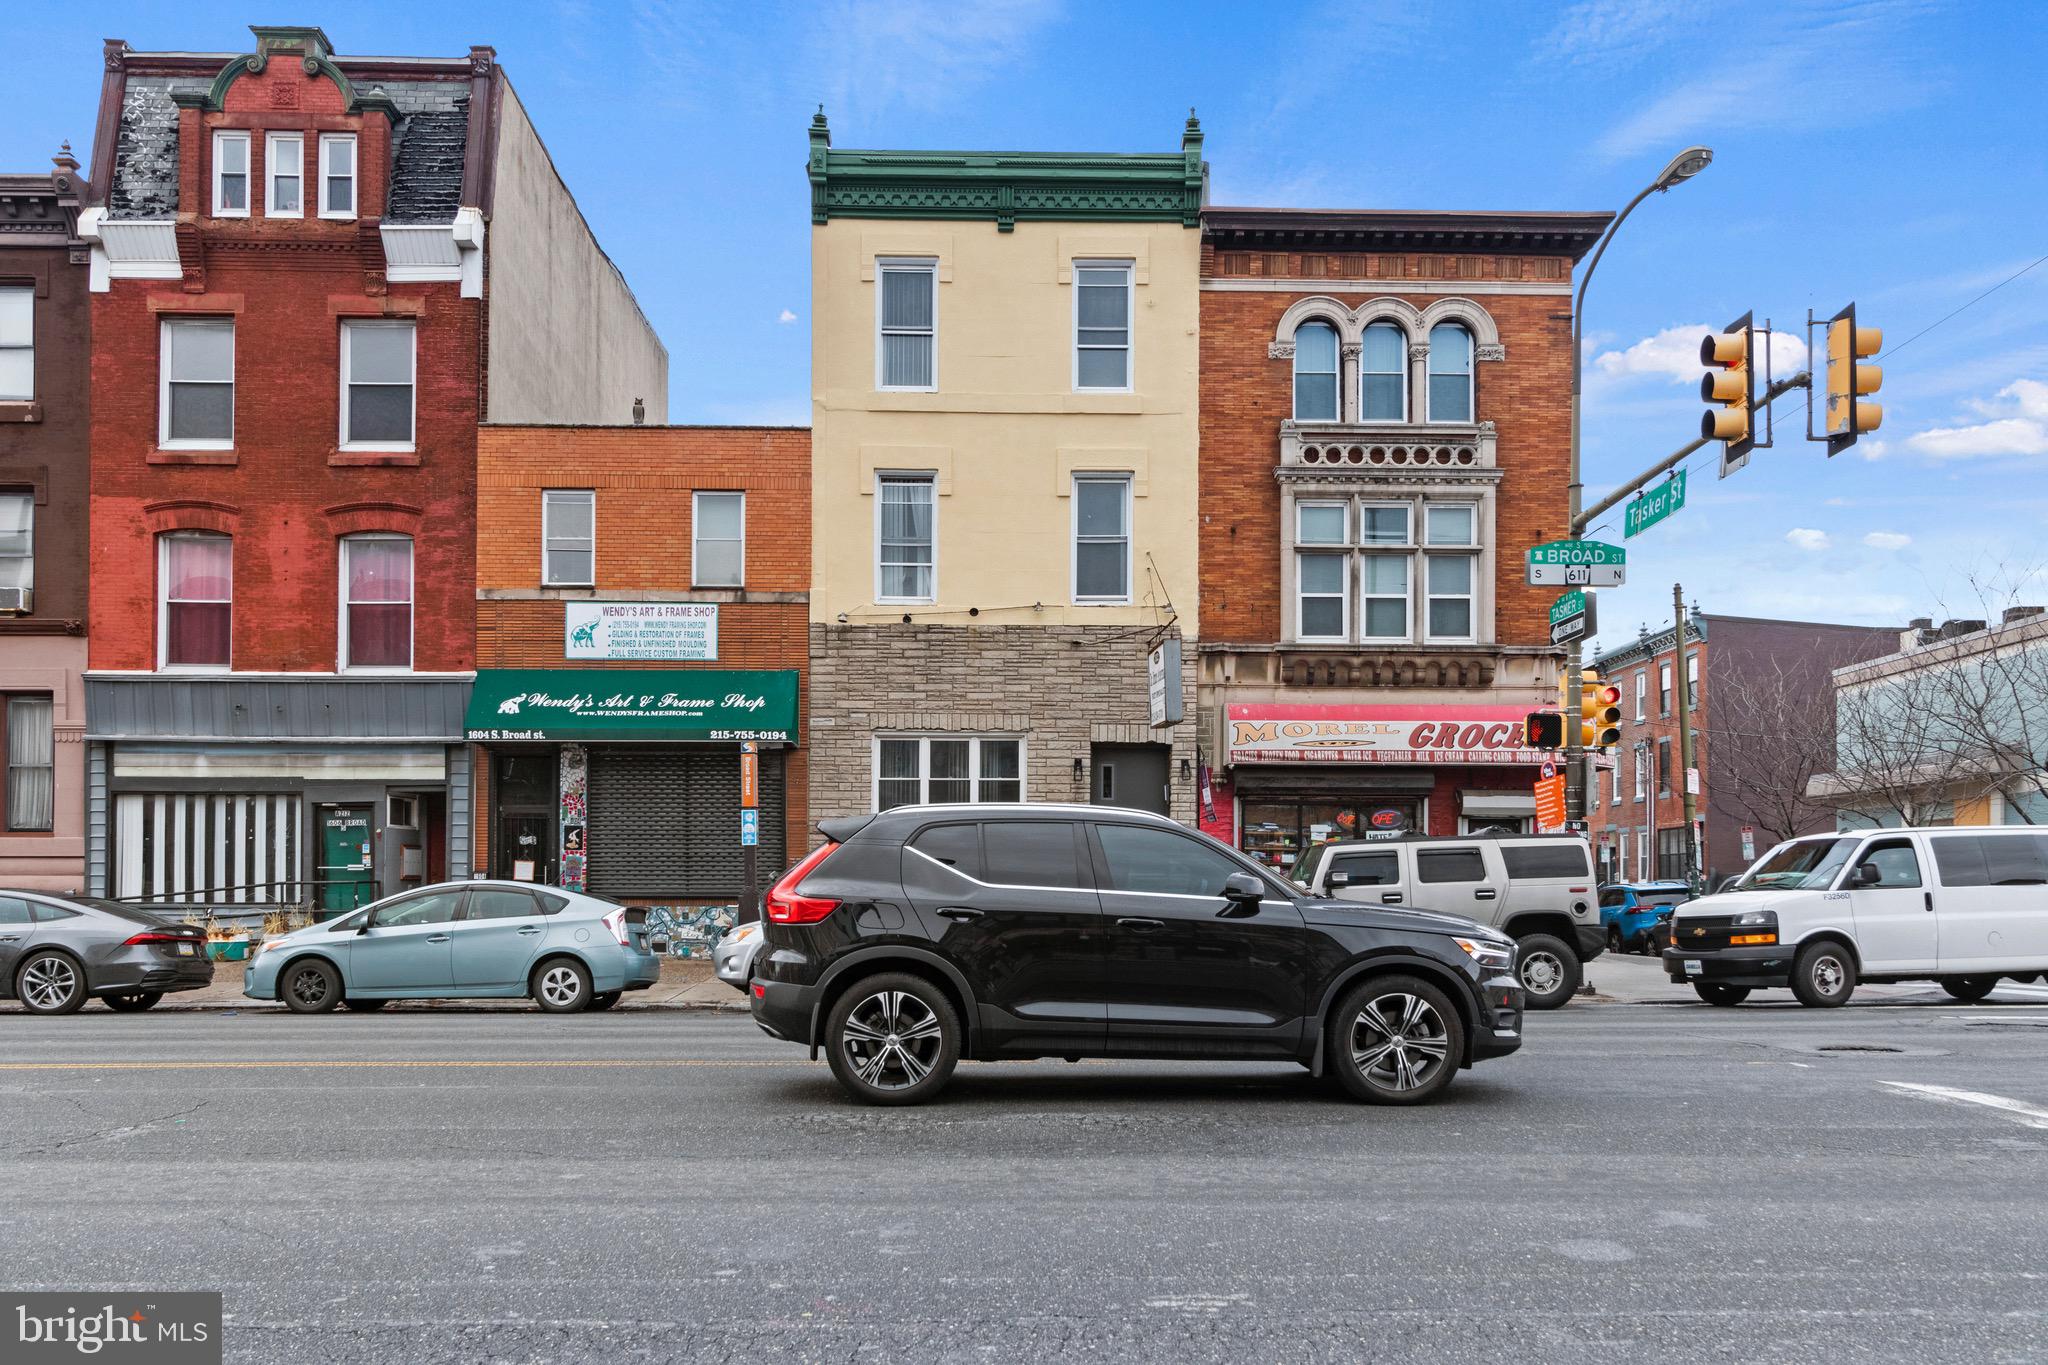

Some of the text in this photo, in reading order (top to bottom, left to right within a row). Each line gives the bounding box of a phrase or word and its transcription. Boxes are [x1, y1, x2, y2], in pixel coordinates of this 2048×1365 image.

[1630, 480, 1682, 527] Tasker St
[1547, 550, 1622, 562] BROAD ST
[1535, 569, 1622, 581] S 611 N
[603, 606, 716, 616] WENDY'S ART & FRAME SHOP
[1552, 600, 1577, 621] TASKER
[612, 630, 633, 638] GILDING
[528, 693, 766, 713] Wendy's Art & Frame Shop
[468, 730, 546, 739] 1604 S. Broad st.
[710, 730, 787, 740] 215-755-0194
[1233, 721, 1525, 749] MOREL GROCE
[1284, 751, 1300, 760] FOOD
[1304, 751, 1339, 760] CIGARETTES
[1416, 751, 1430, 761] MILK
[1444, 752, 1463, 761] CREAM
[1468, 752, 1493, 761] CALLING
[1493, 752, 1512, 761] CARDS
[1516, 752, 1531, 762] FOOD
